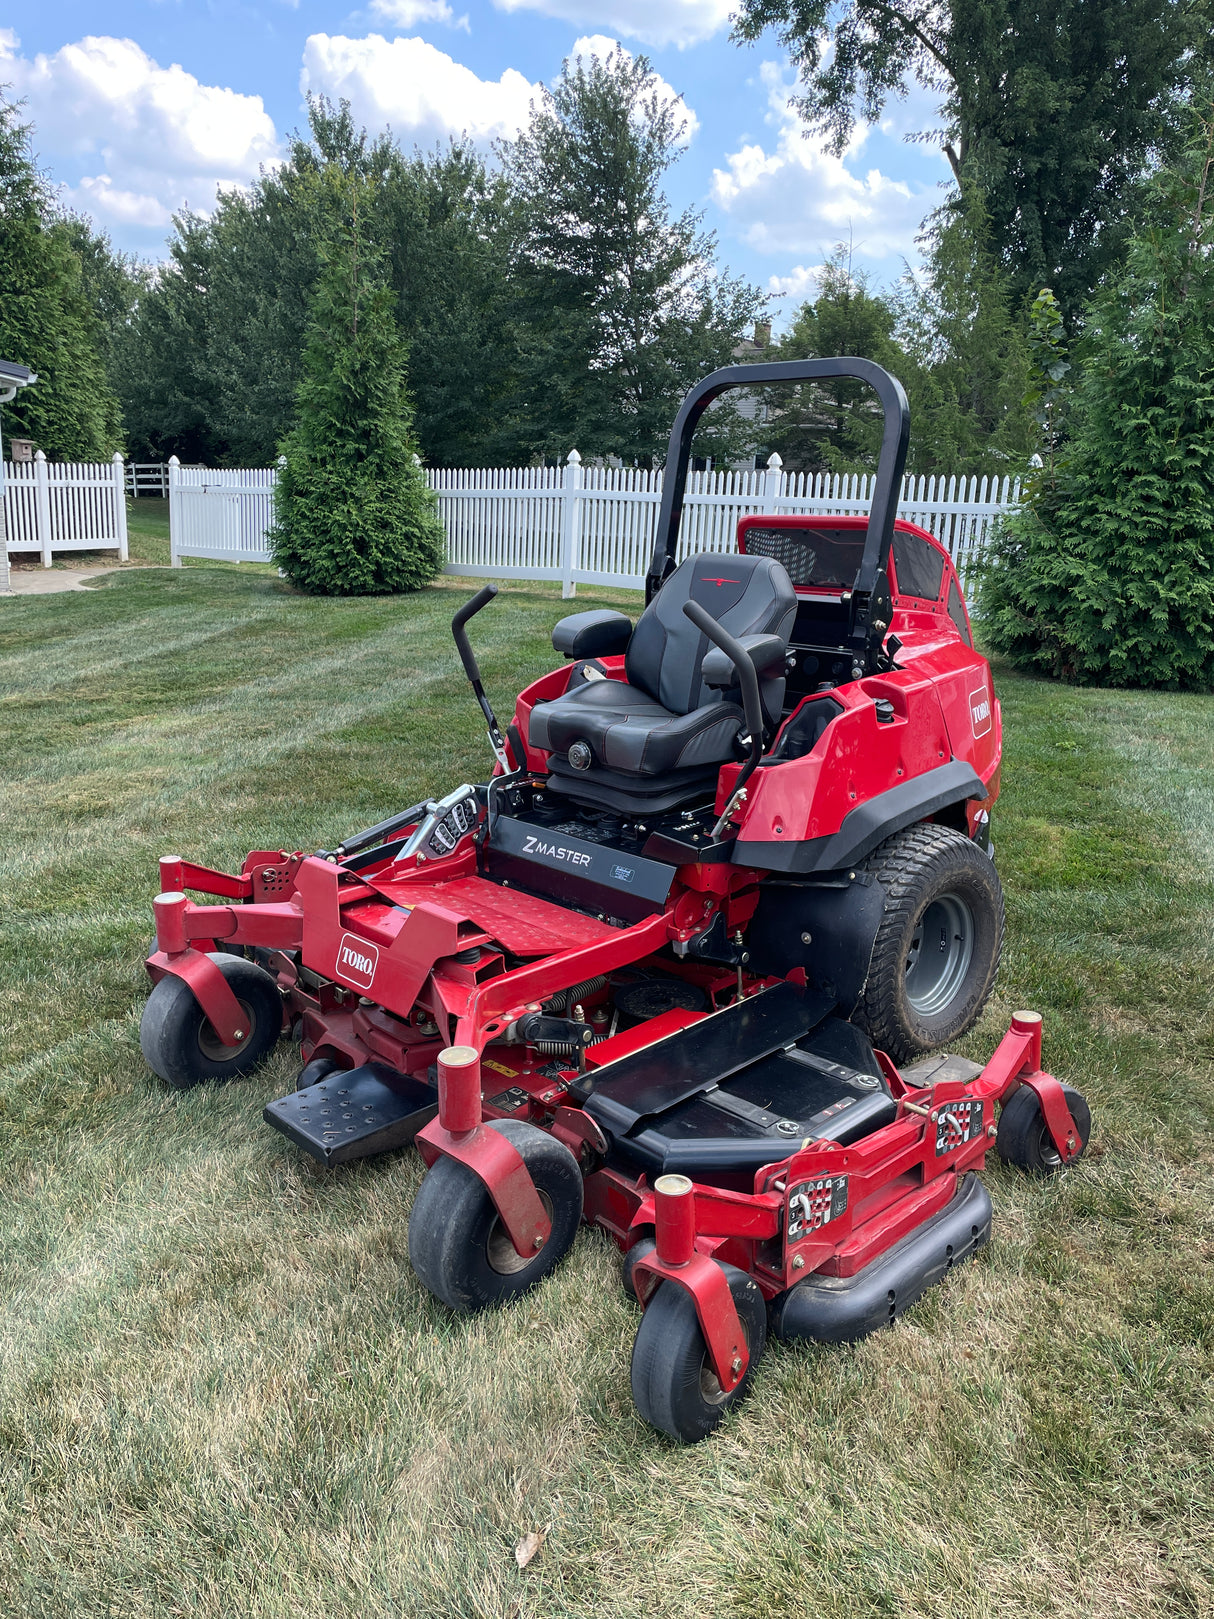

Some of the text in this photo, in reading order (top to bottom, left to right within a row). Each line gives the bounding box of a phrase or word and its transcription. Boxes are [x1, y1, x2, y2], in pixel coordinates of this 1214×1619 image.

[972, 701, 990, 724] TORO
[535, 842, 592, 867] MASTER
[342, 946, 373, 976] TORO
